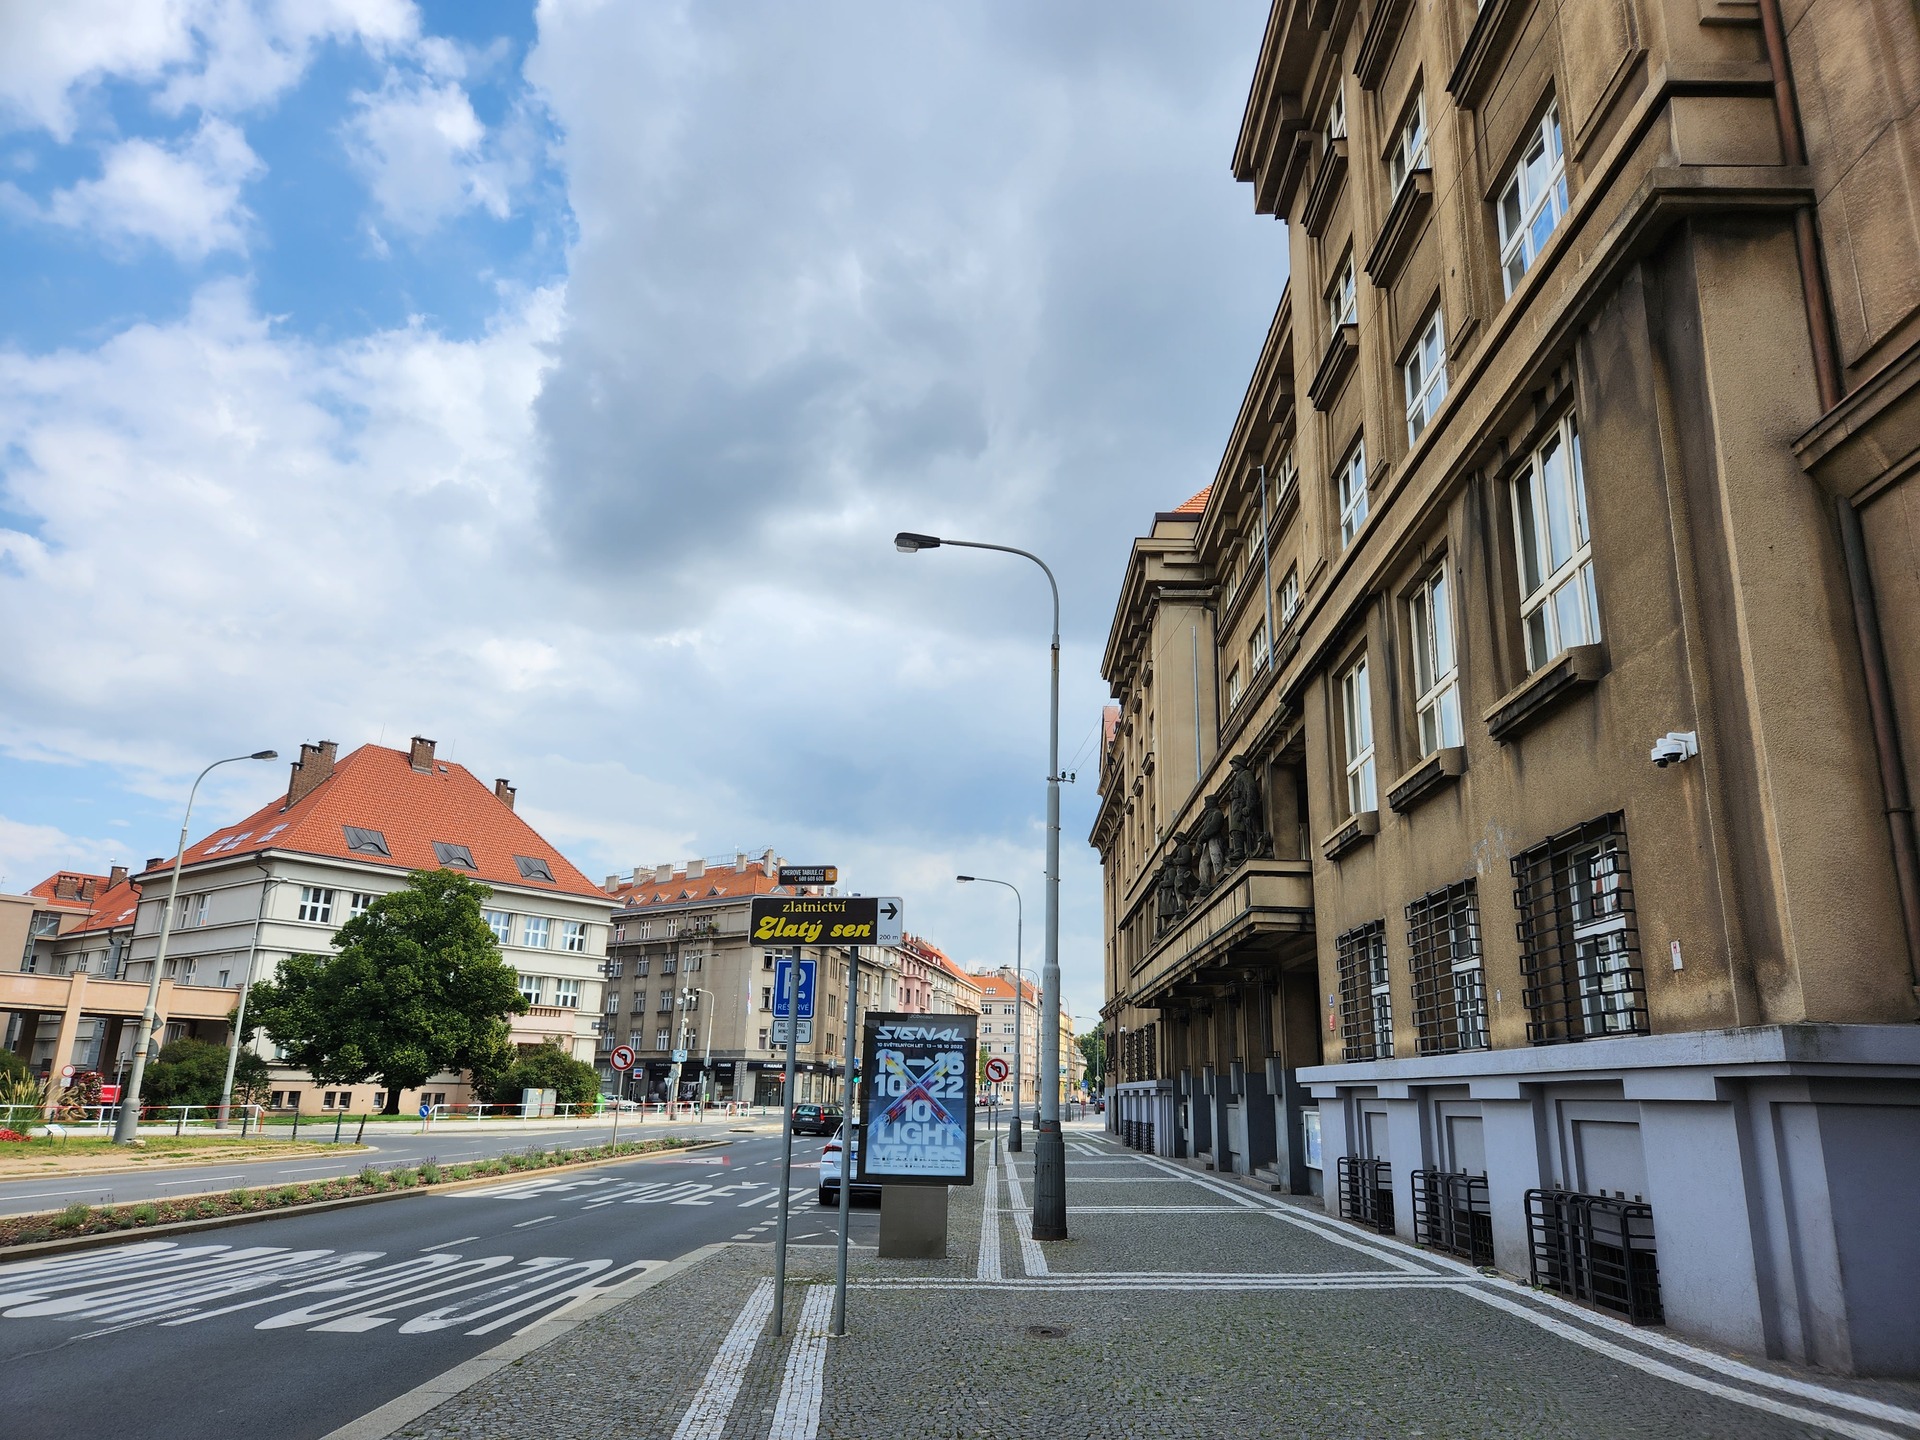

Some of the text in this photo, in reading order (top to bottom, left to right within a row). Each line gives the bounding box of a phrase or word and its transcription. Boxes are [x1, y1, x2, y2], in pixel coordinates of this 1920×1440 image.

[782, 900, 847, 913] zlatnictví
[753, 915, 823, 943] Zlatý
[777, 1002, 809, 1011] RÉSRVÉ
[875, 1026, 966, 1042] SIGNAL
[874, 1074, 964, 1099] 10 22
[902, 1099, 932, 1122] 10
[877, 1122, 957, 1146] LIGHT
[872, 1144, 962, 1160] YEARS
[158, 1254, 668, 1336] POZOR
